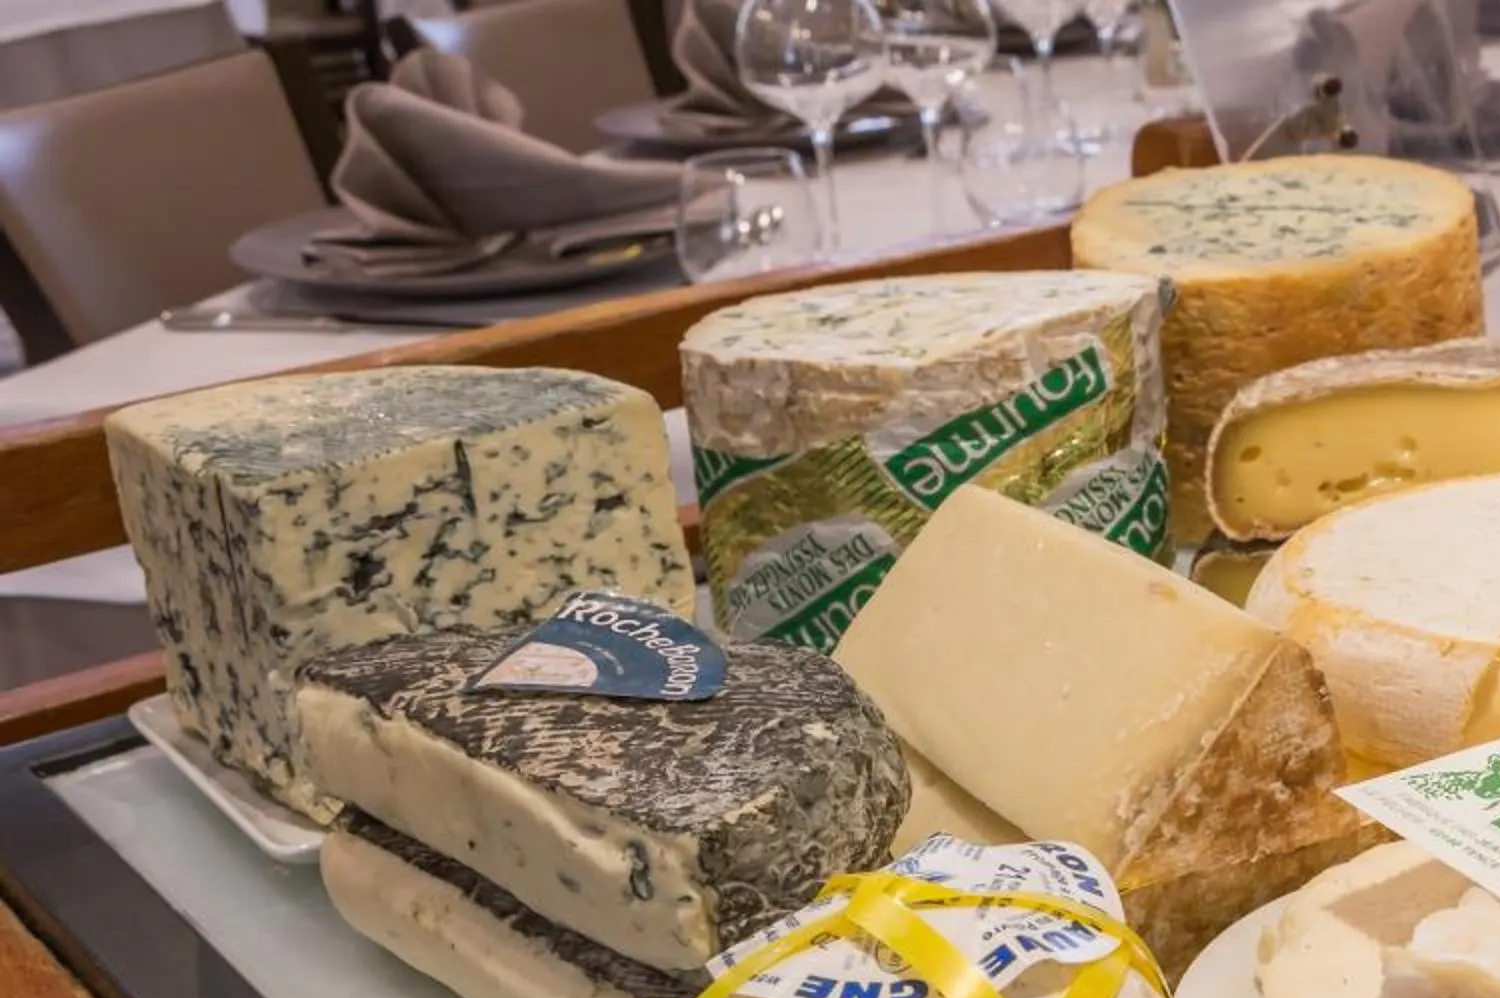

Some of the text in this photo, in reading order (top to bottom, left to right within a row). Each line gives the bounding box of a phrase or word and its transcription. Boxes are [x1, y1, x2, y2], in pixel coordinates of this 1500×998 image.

[903, 347, 1098, 497] fourme
[768, 533, 875, 611] DES MONTS
